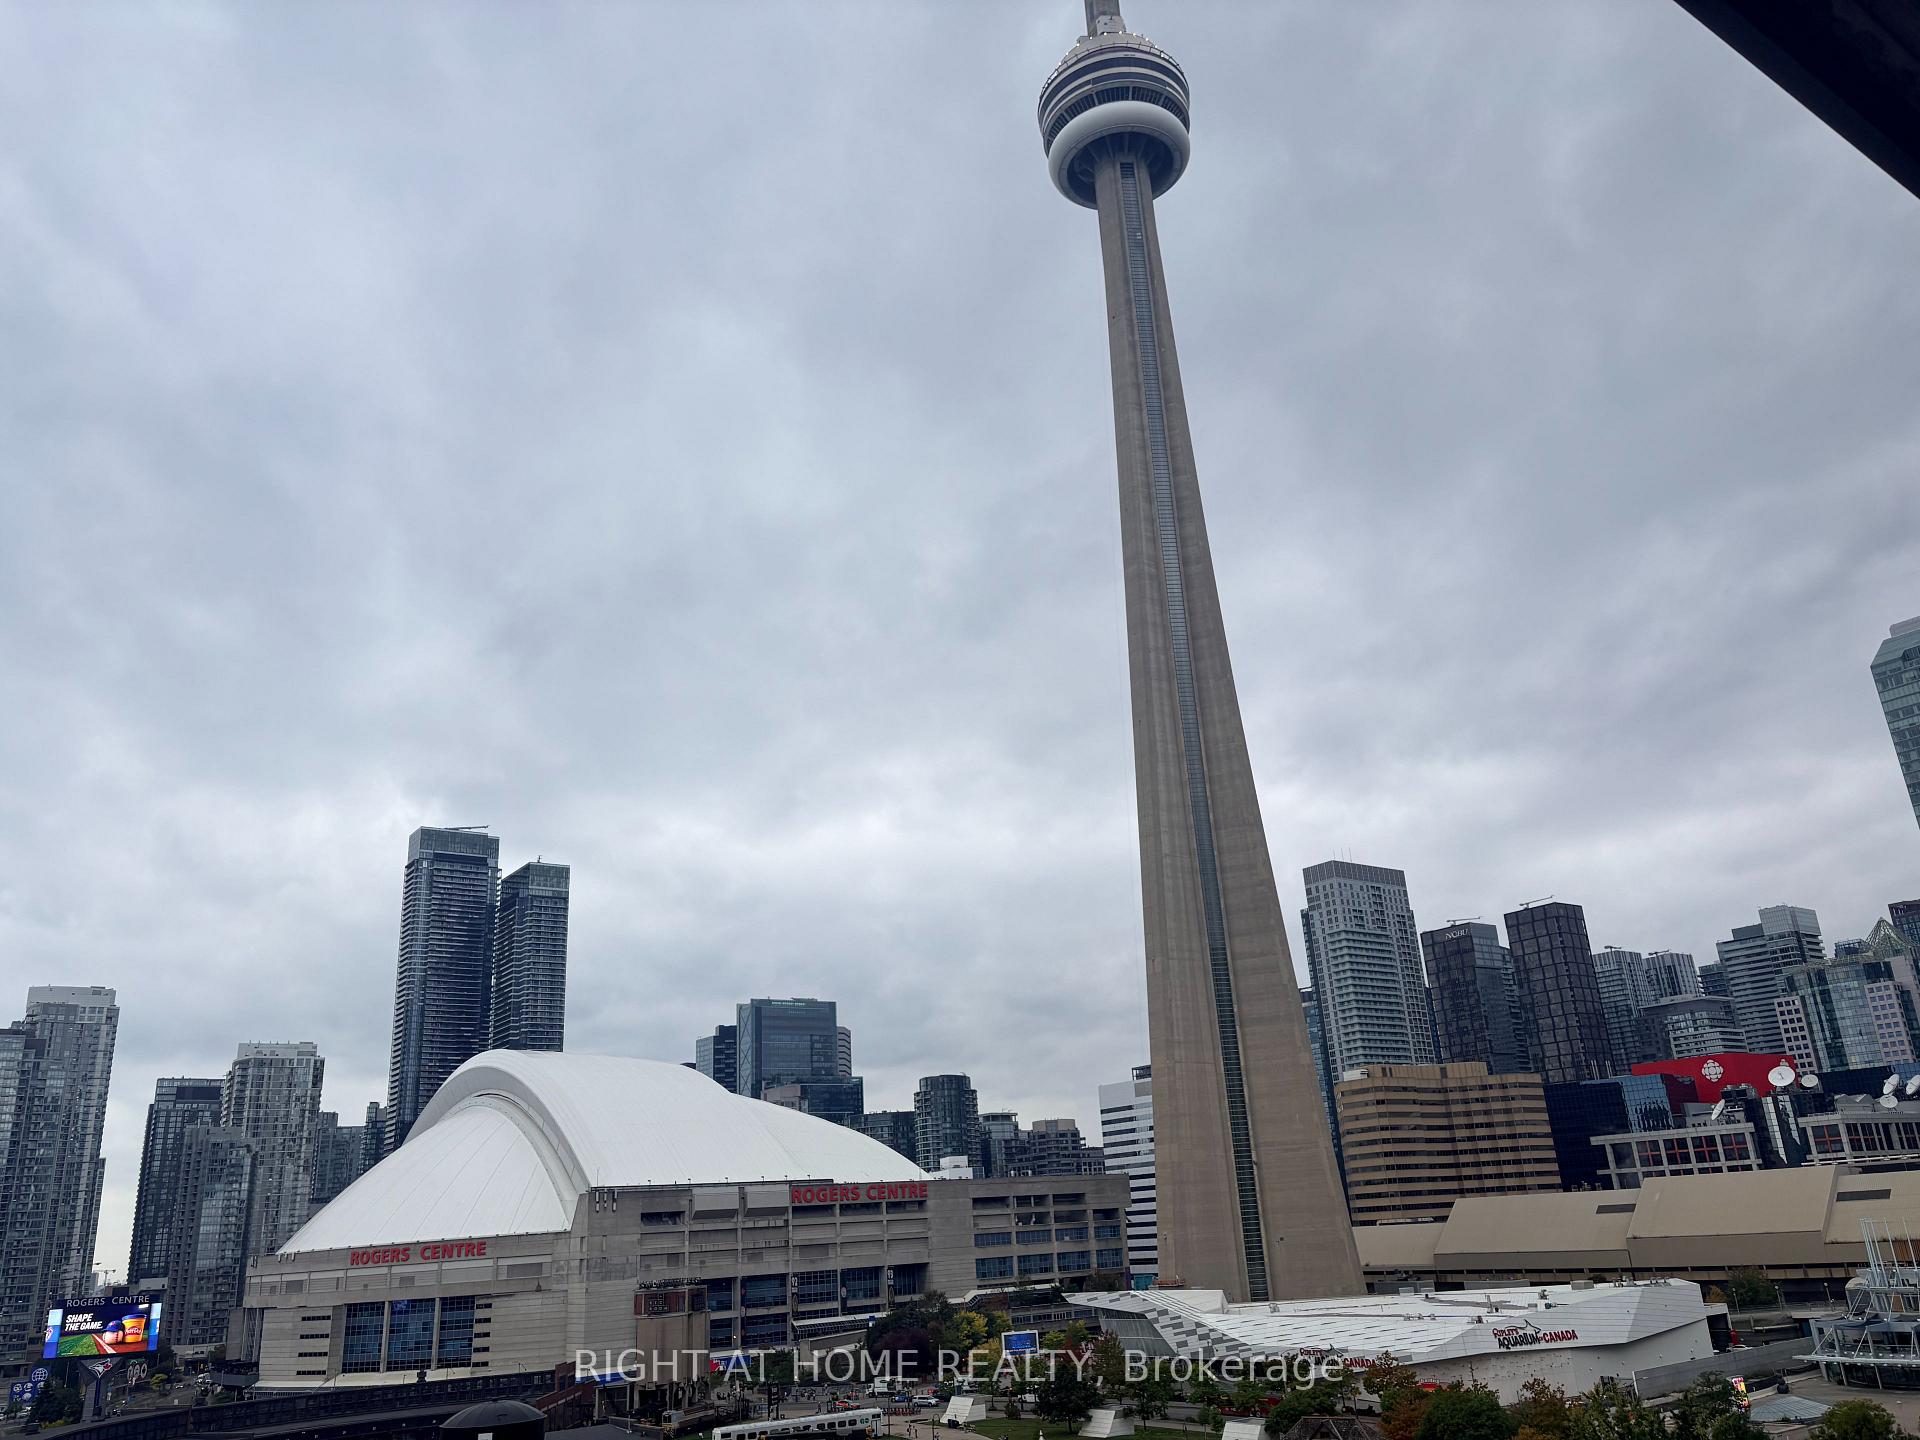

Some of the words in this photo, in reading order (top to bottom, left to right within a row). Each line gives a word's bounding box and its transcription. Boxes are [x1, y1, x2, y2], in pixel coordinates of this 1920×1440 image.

[1445, 929, 1468, 940] NOBU
[791, 1185, 861, 1204] ROGERS
[867, 1183, 928, 1200] CENTRE
[350, 1247, 410, 1266] ROGERS
[420, 1241, 487, 1260] CENTRE
[66, 1297, 105, 1308] ROGERS
[111, 1295, 150, 1305] CENTRE
[66, 1313, 94, 1323] SHAPE
[64, 1323, 81, 1331] THE
[1497, 1332, 1541, 1349] AQUARIUM
[1543, 1330, 1579, 1343] CANADA
[1342, 1357, 1377, 1368] CANADA
